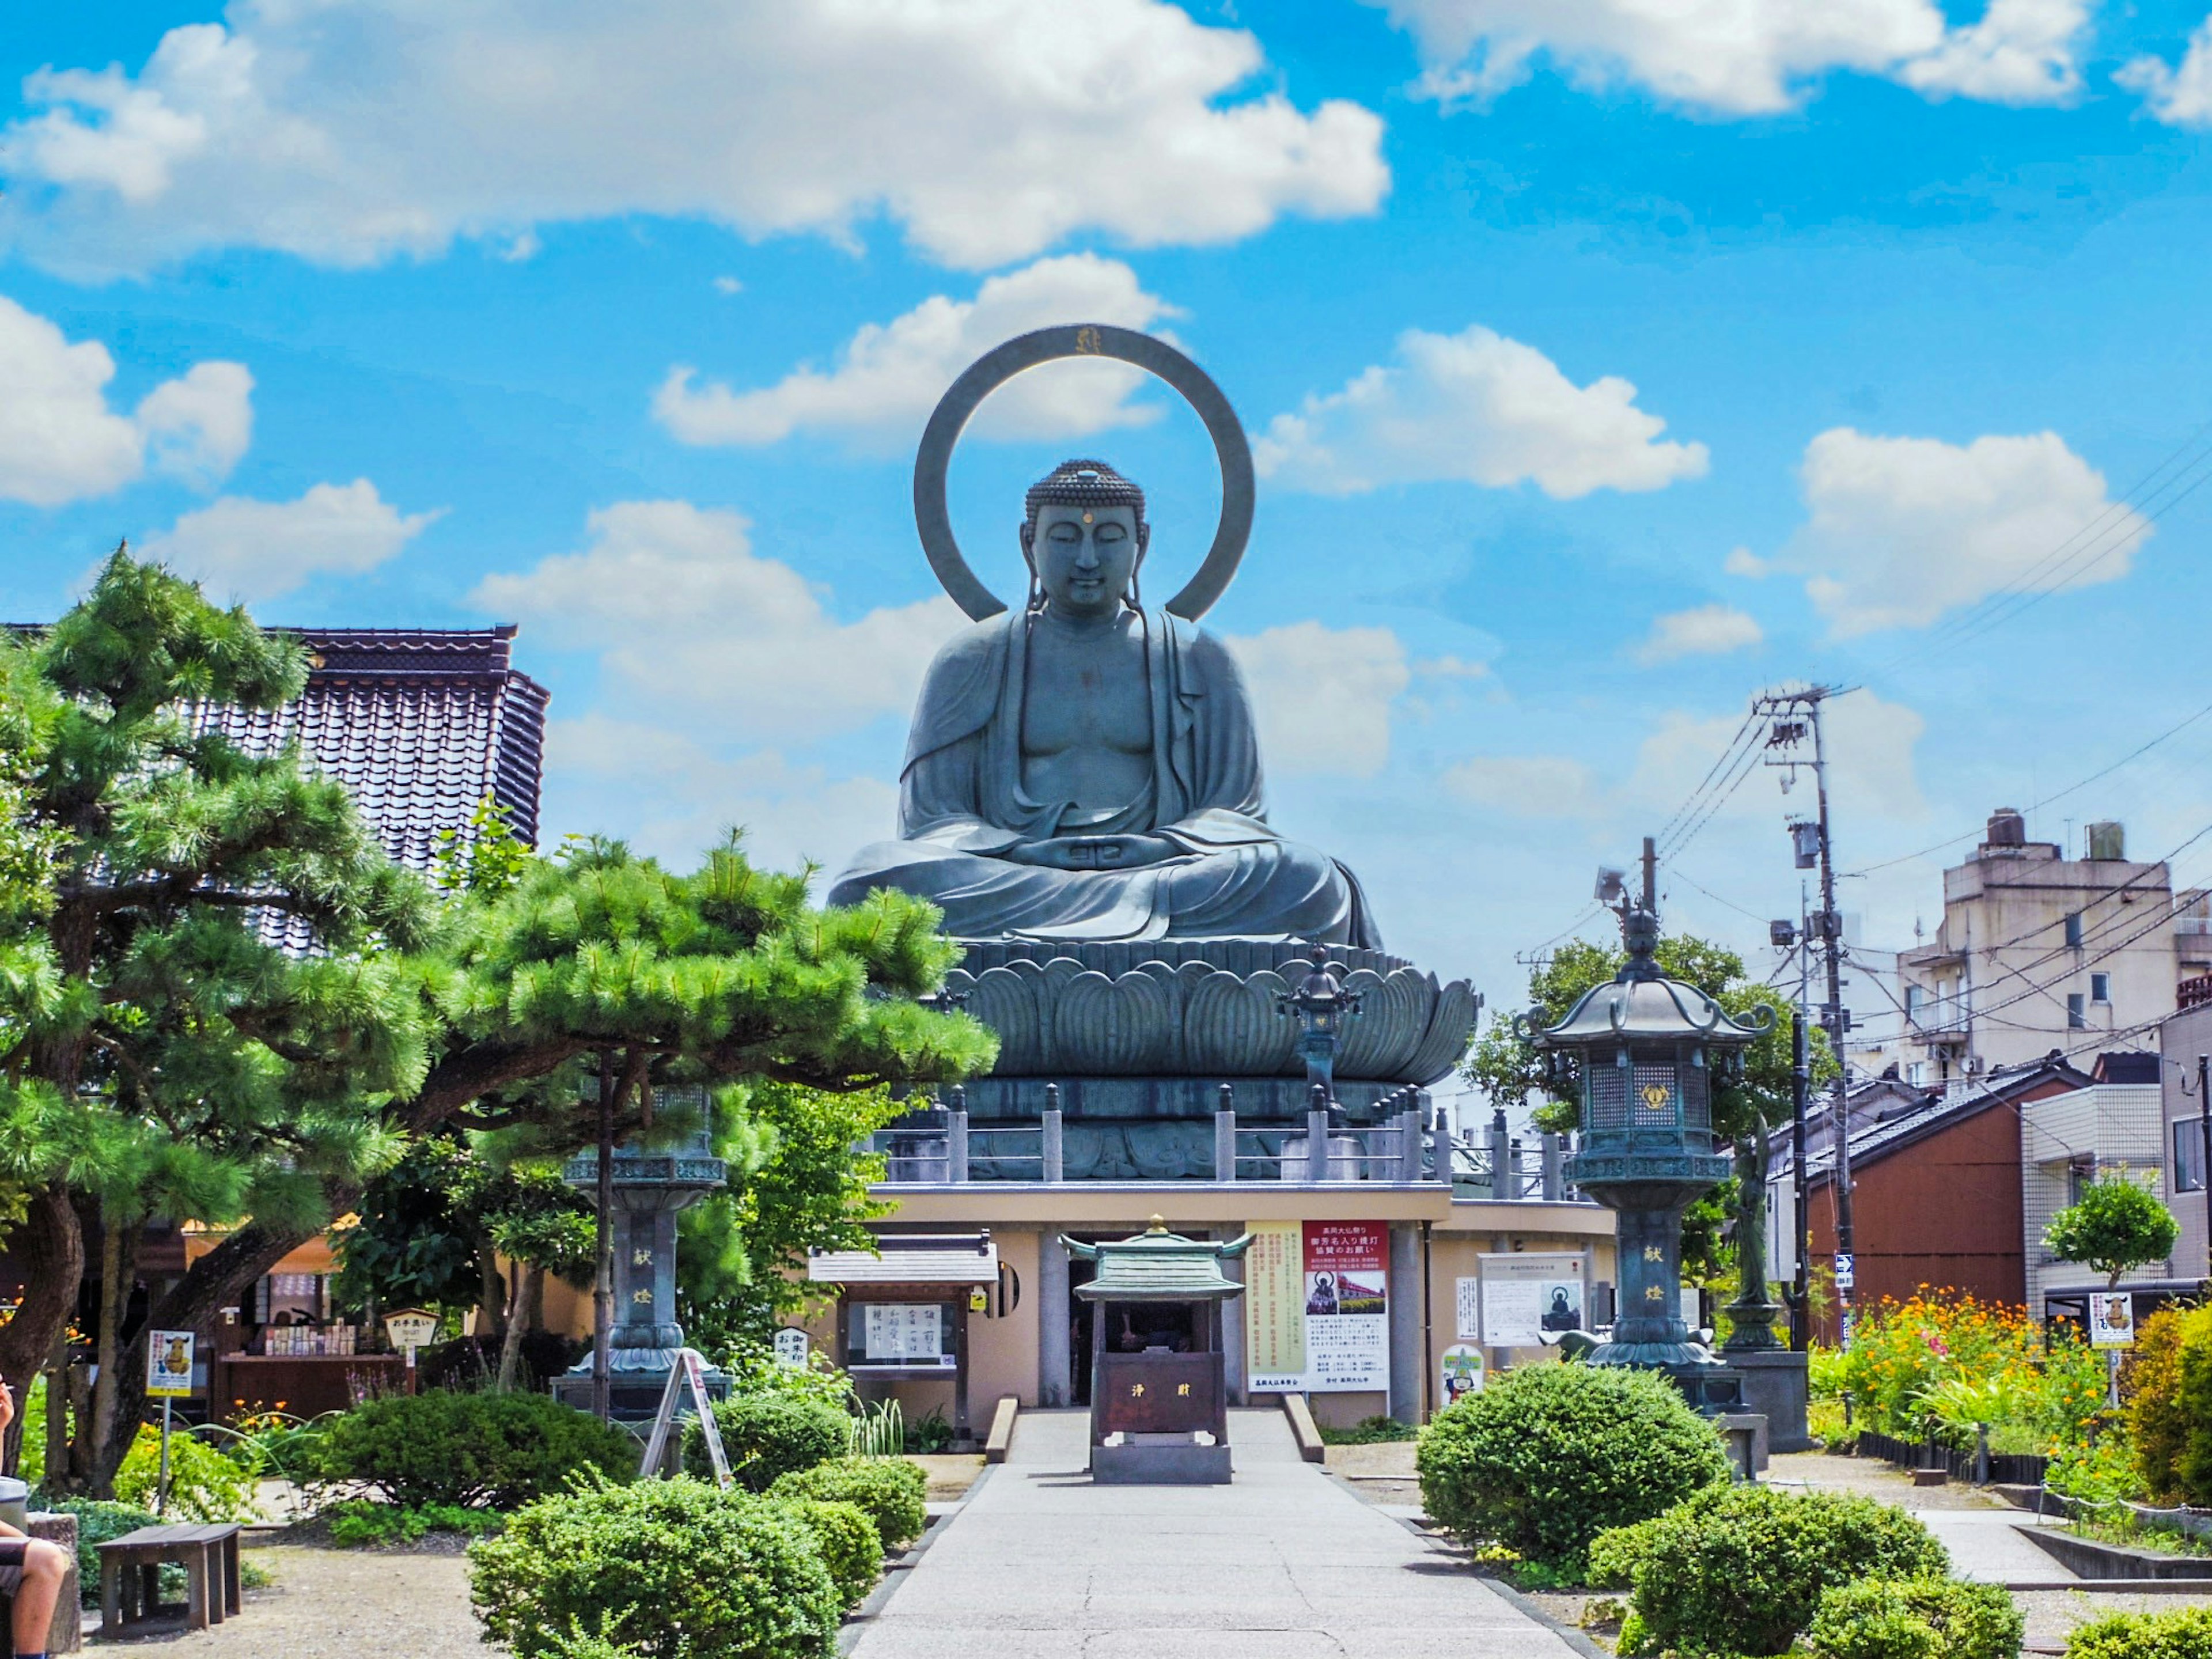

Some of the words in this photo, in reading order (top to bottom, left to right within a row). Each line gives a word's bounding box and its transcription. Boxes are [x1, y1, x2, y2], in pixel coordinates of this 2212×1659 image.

[1311, 1236, 1378, 1246] 御芳名入り提灯
[1316, 1246, 1373, 1255] 協賛のお願い
[793, 1335, 804, 1362] 御朱印
